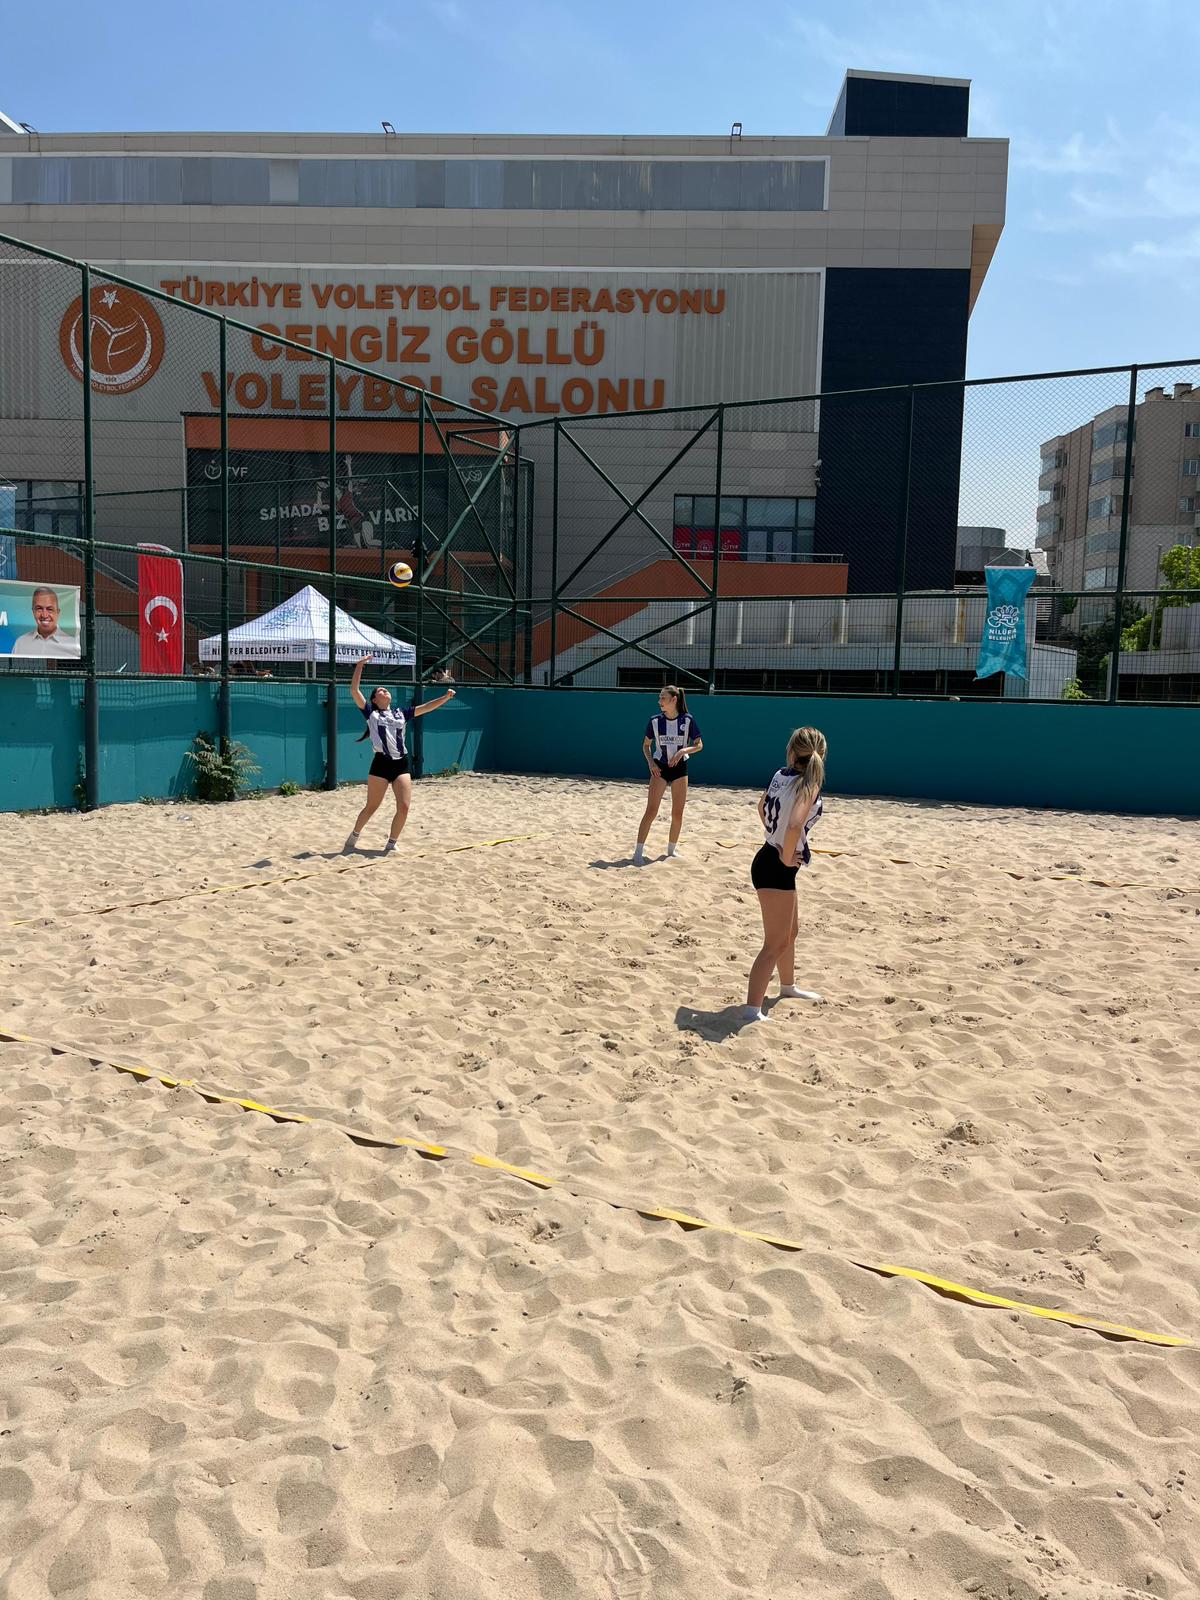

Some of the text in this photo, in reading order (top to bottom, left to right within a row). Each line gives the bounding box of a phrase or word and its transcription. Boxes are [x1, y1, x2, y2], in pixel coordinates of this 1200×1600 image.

[160, 275, 726, 314] TÜRKİYE VOLEYBOL FEDERASYONU
[251, 316, 605, 366] CENGİZ GÖLLÜ
[201, 371, 665, 414] VOLEYBOL SALONU
[318, 514, 346, 532] BZ
[211, 644, 290, 656] NİFER BELEDİYESİ
